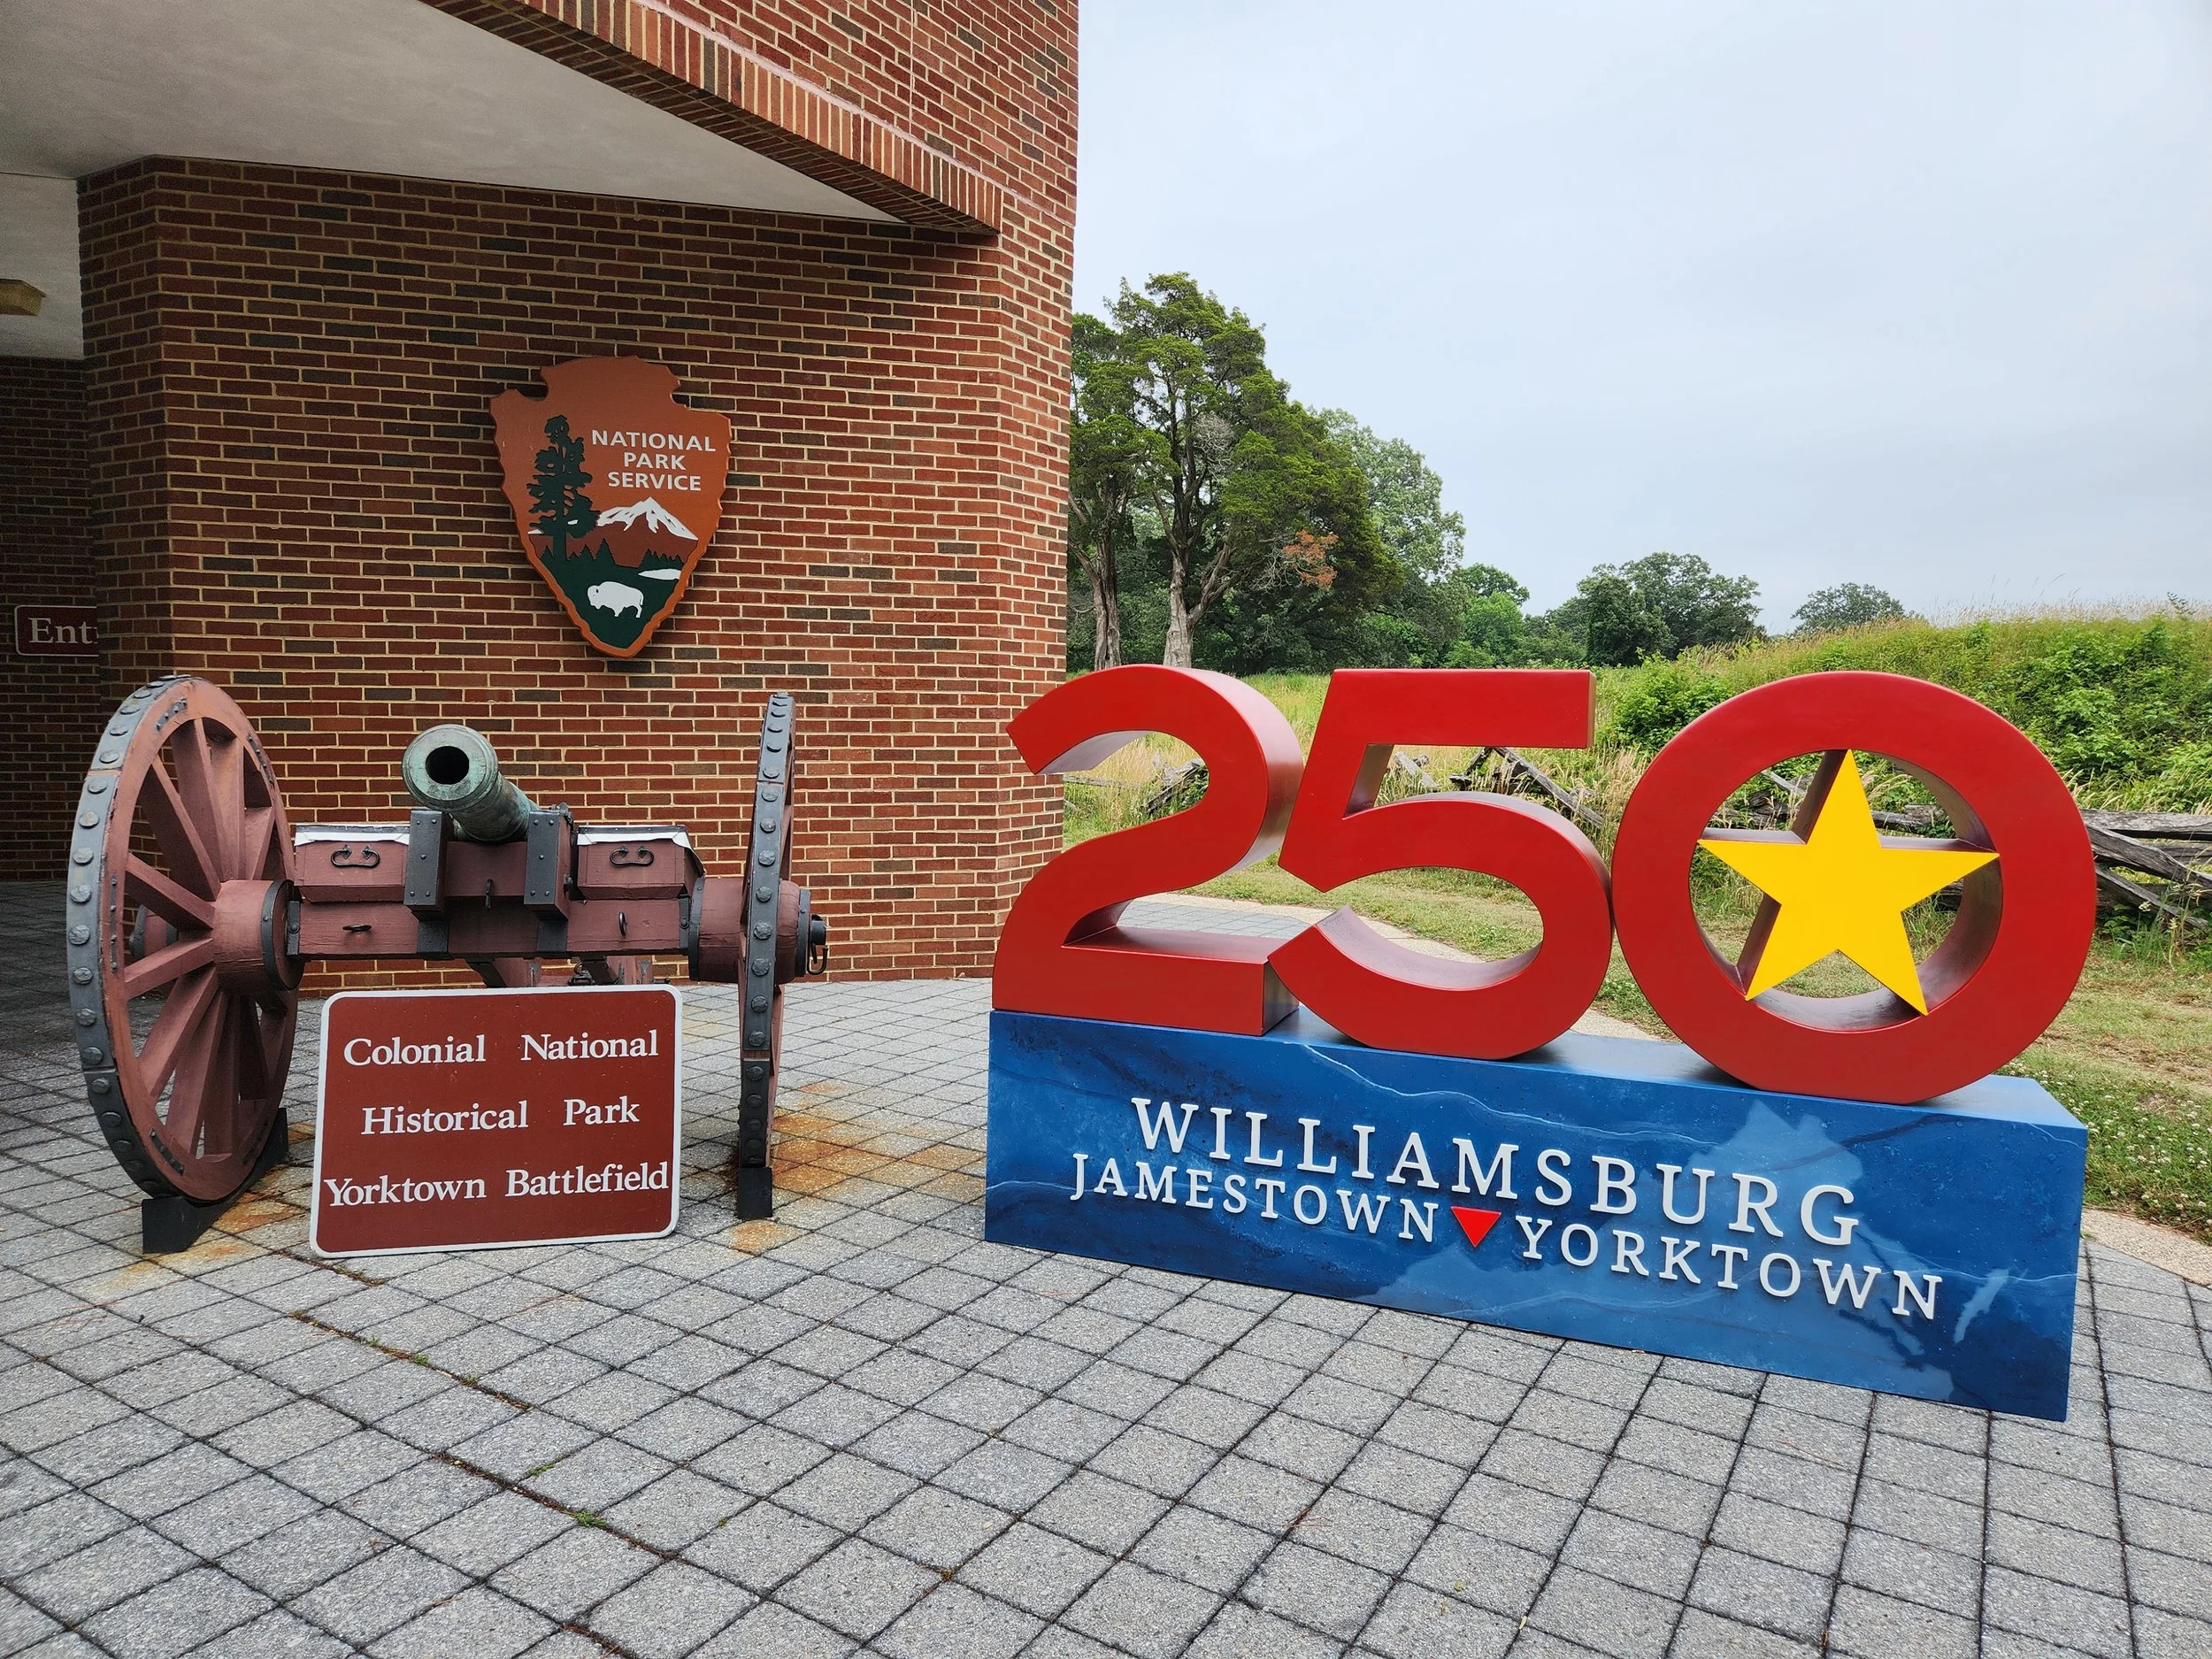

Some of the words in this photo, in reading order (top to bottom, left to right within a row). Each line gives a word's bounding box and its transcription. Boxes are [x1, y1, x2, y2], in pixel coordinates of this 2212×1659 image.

[591, 429, 717, 452] NATIONAL
[608, 471, 702, 491] SERVICE
[624, 451, 687, 471] PARK
[992, 662, 2098, 1105] 250
[343, 1033, 487, 1066] Colonial
[520, 1029, 659, 1061] National
[360, 1100, 529, 1135] Historical
[563, 1095, 640, 1126] Park
[324, 1174, 487, 1207] Yorktown
[504, 1161, 669, 1197] Battlefield
[1131, 1097, 1859, 1246] WILLIAMSBURG
[1071, 1153, 1439, 1243] JAMESTOWN
[1515, 1215, 1943, 1320] YORKTOWN
